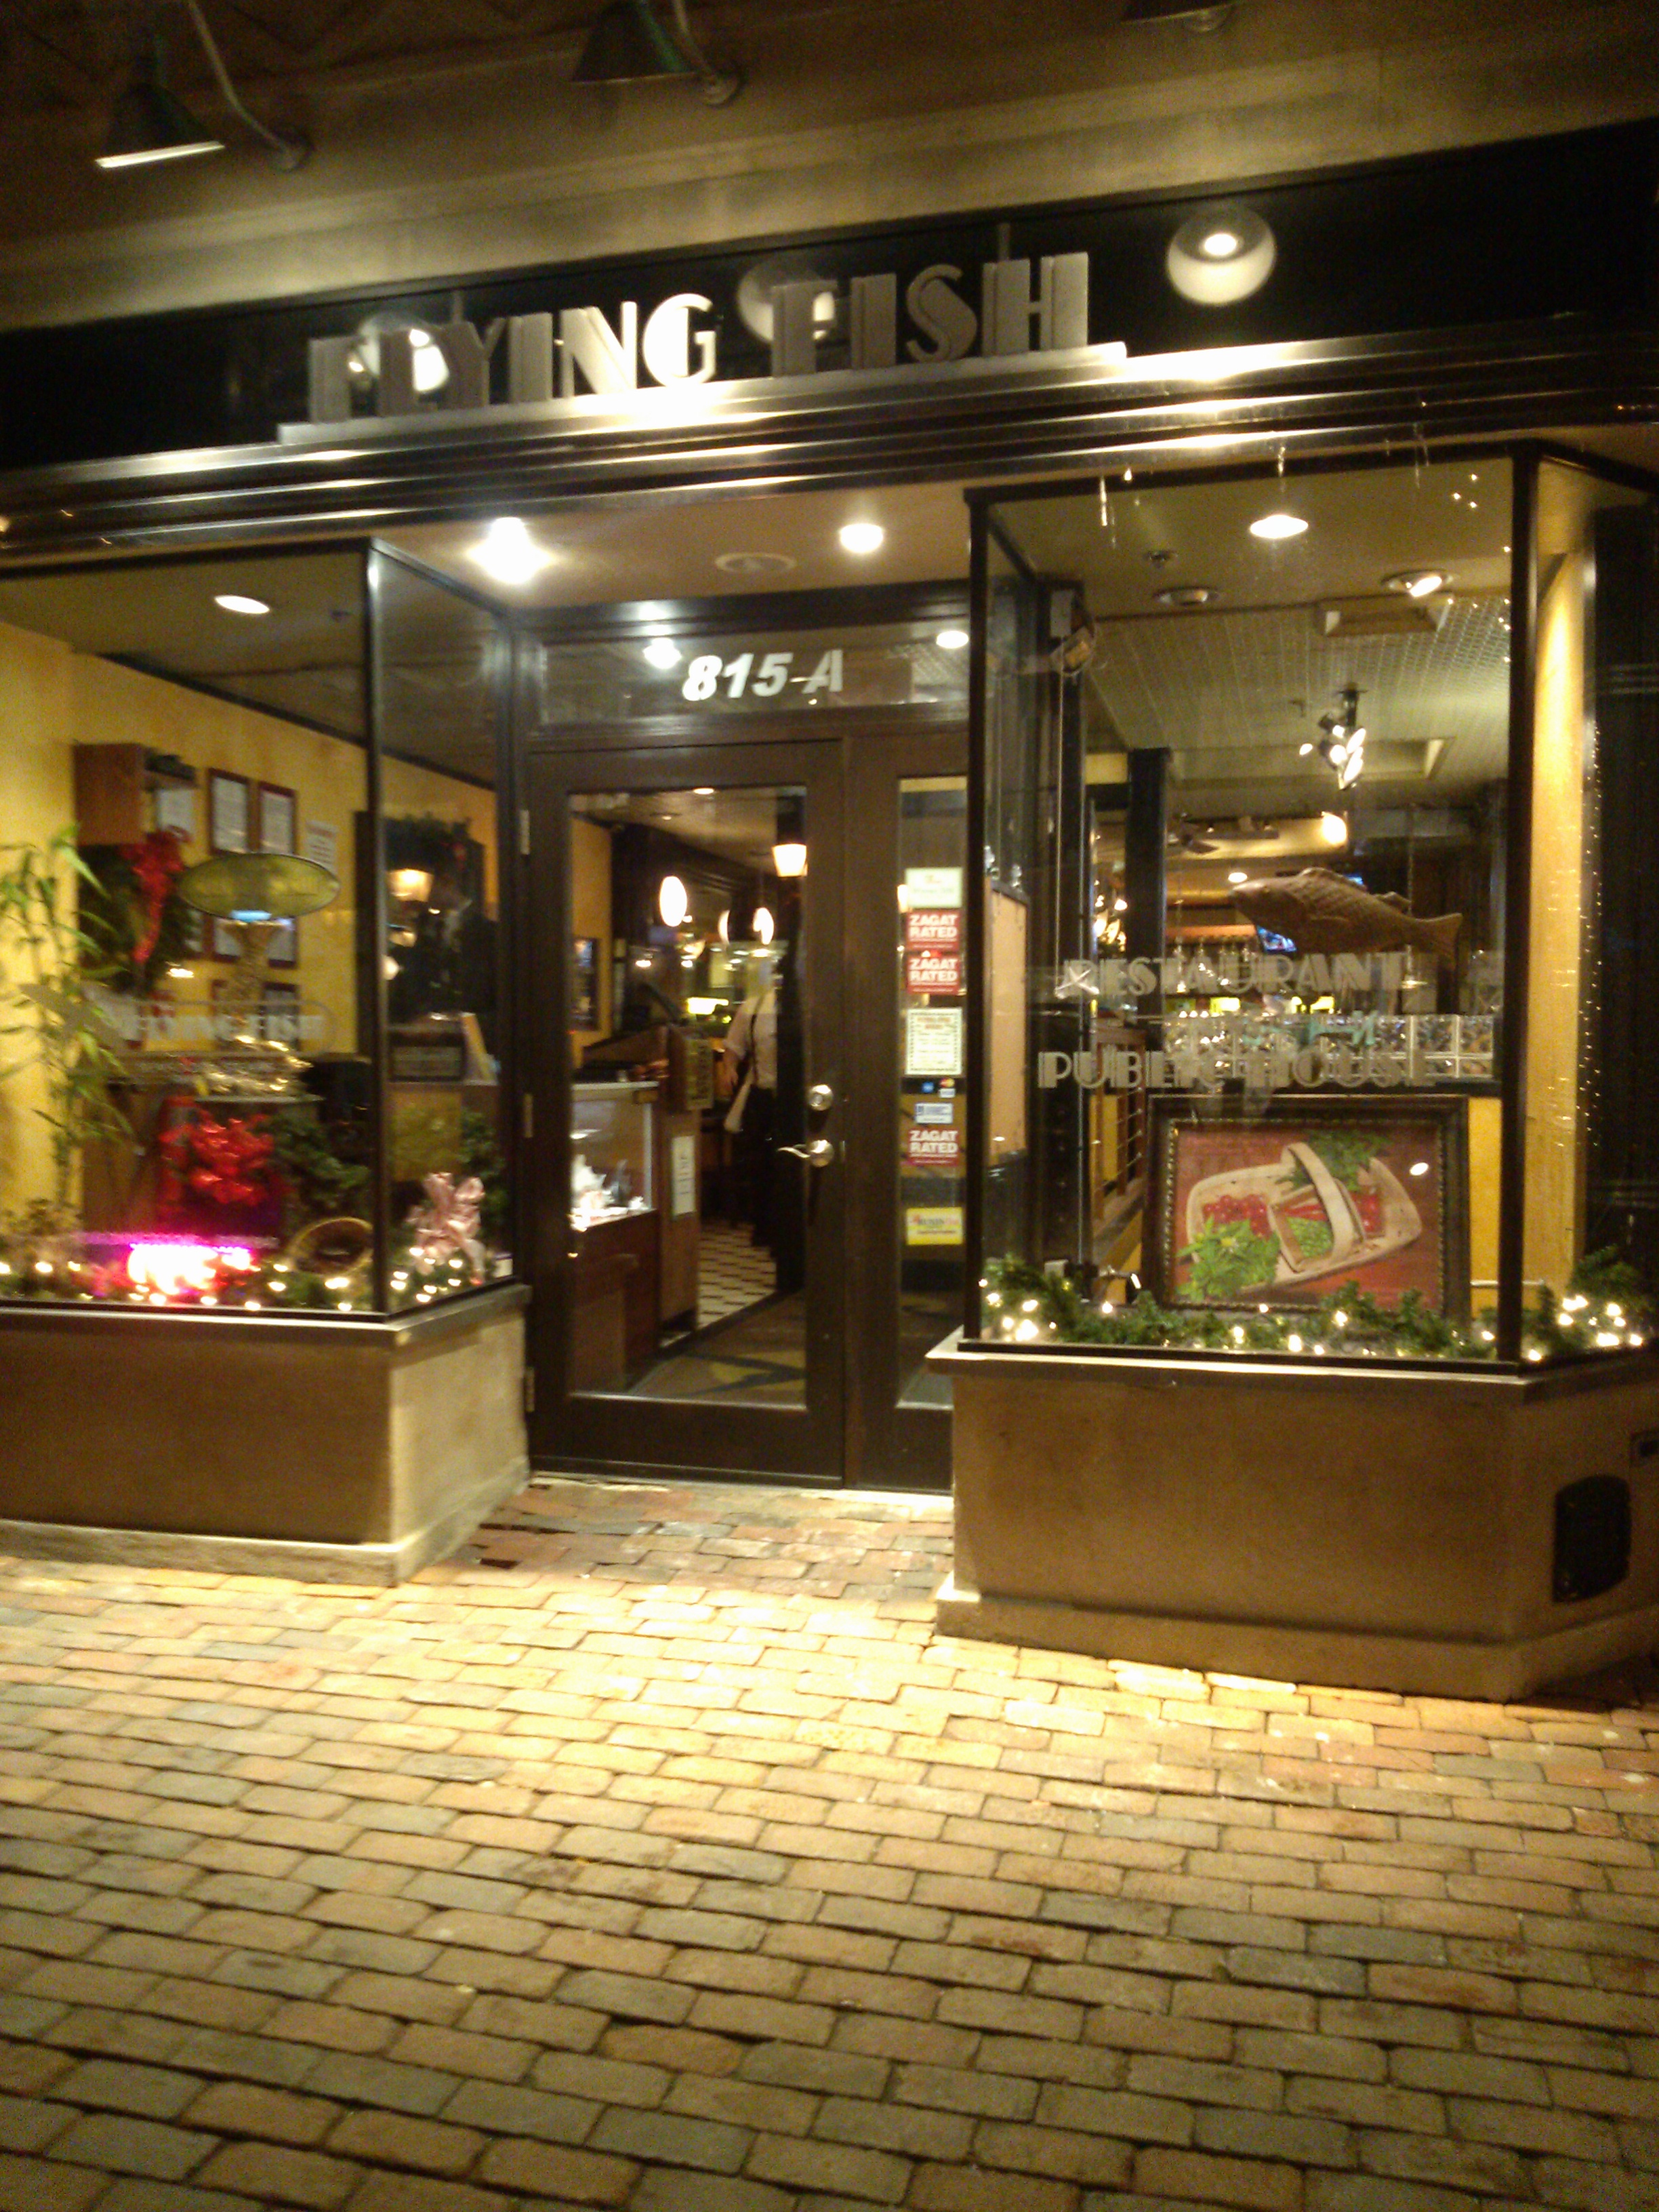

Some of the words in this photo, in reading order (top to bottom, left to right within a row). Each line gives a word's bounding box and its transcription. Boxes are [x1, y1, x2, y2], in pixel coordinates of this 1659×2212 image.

[308, 292, 717, 423] FLYING
[771, 251, 1090, 377] FISH
[909, 914, 958, 926] ZAGAT
[909, 926, 958, 938] RATED
[909, 958, 958, 970] ZAGAT
[909, 970, 958, 982] RATED
[1063, 951, 1408, 996] RESTAURANT
[909, 1130, 958, 1141] ZAGAT
[909, 1142, 958, 1153] RATED
